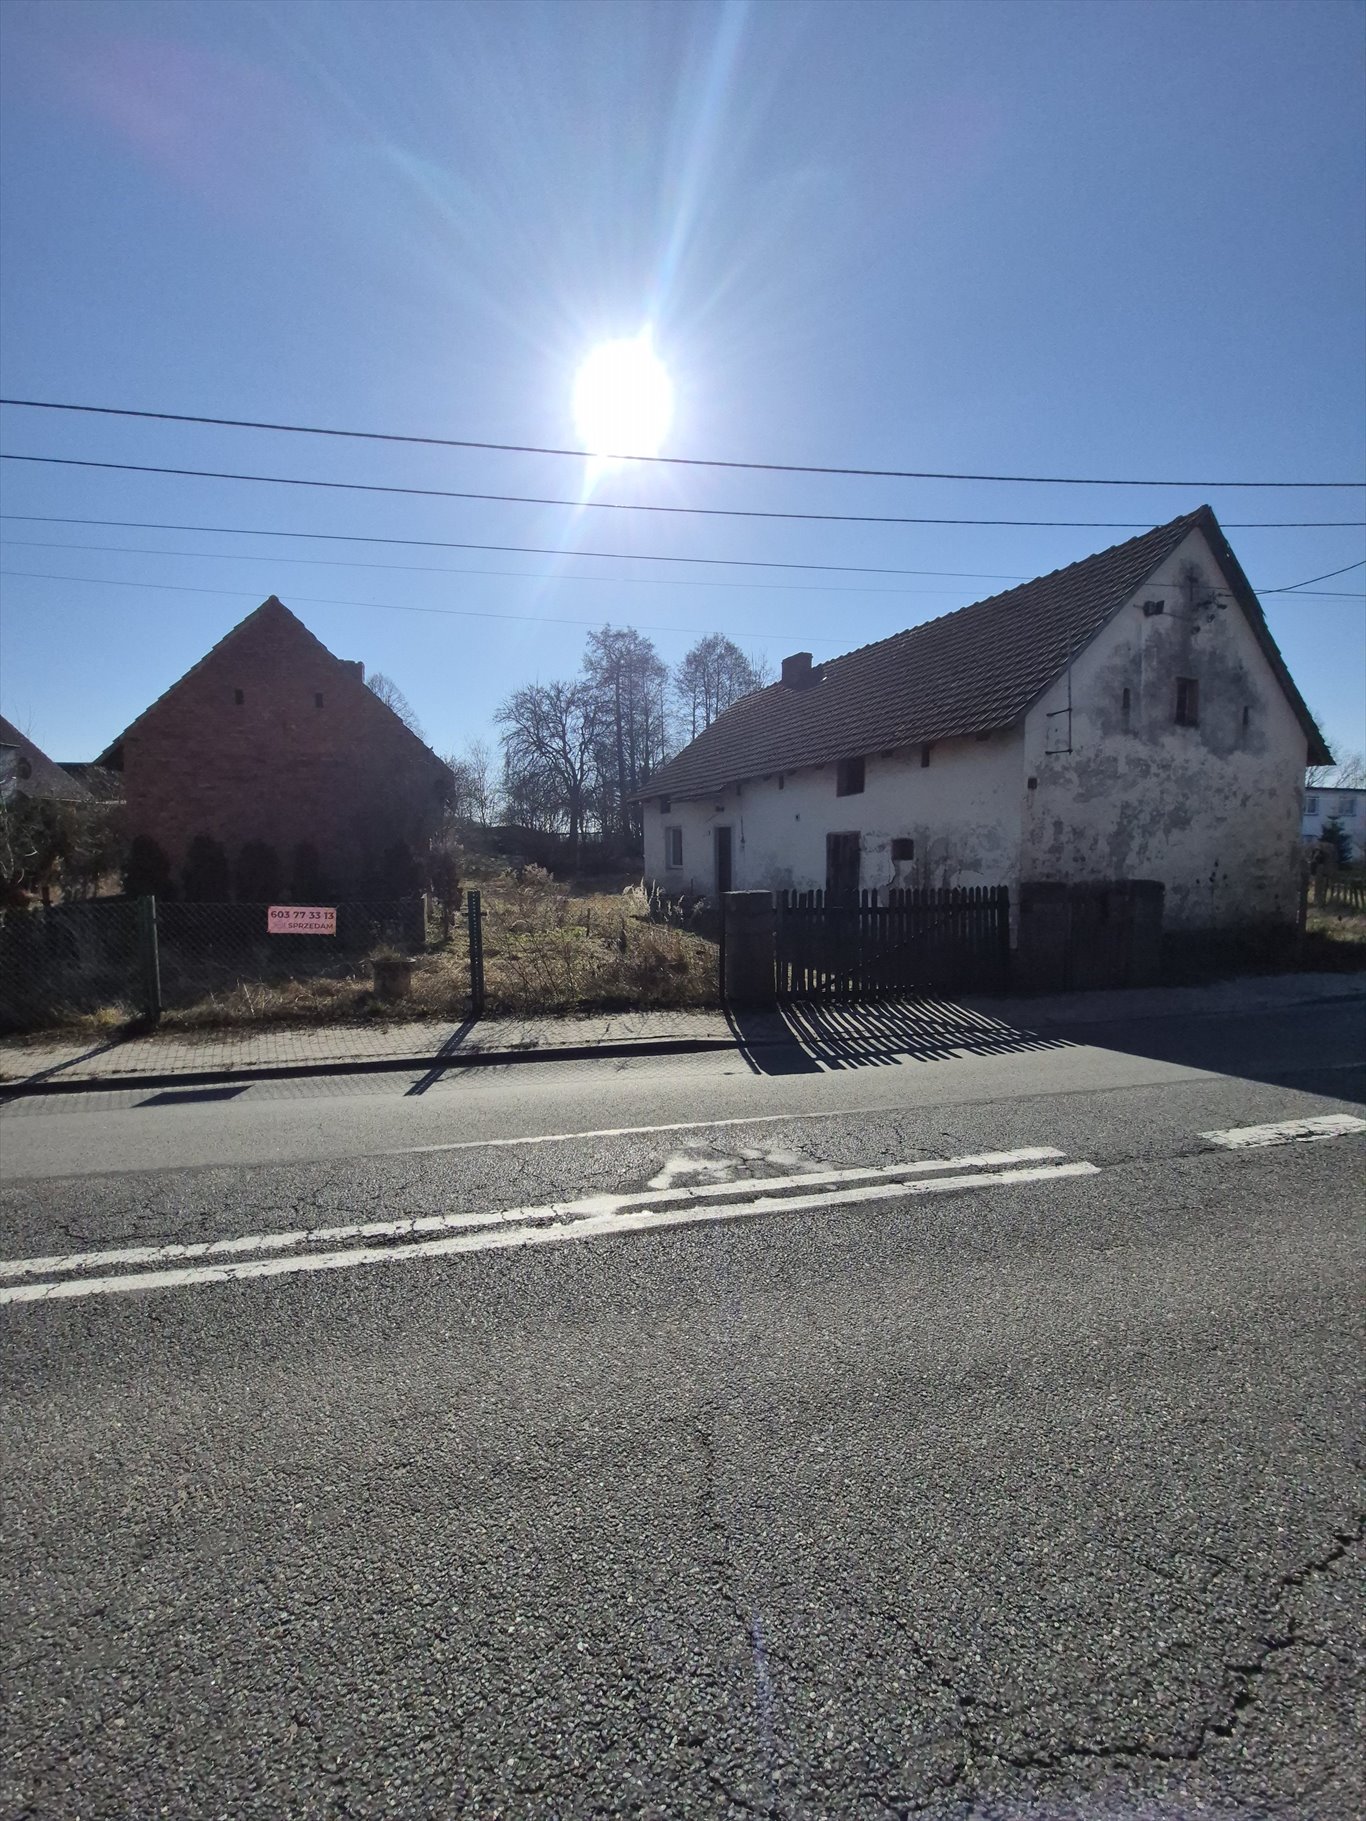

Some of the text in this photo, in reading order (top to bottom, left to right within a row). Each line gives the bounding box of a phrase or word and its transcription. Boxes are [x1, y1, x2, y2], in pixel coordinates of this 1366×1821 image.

[270, 911, 334, 920] 603 77 33 13
